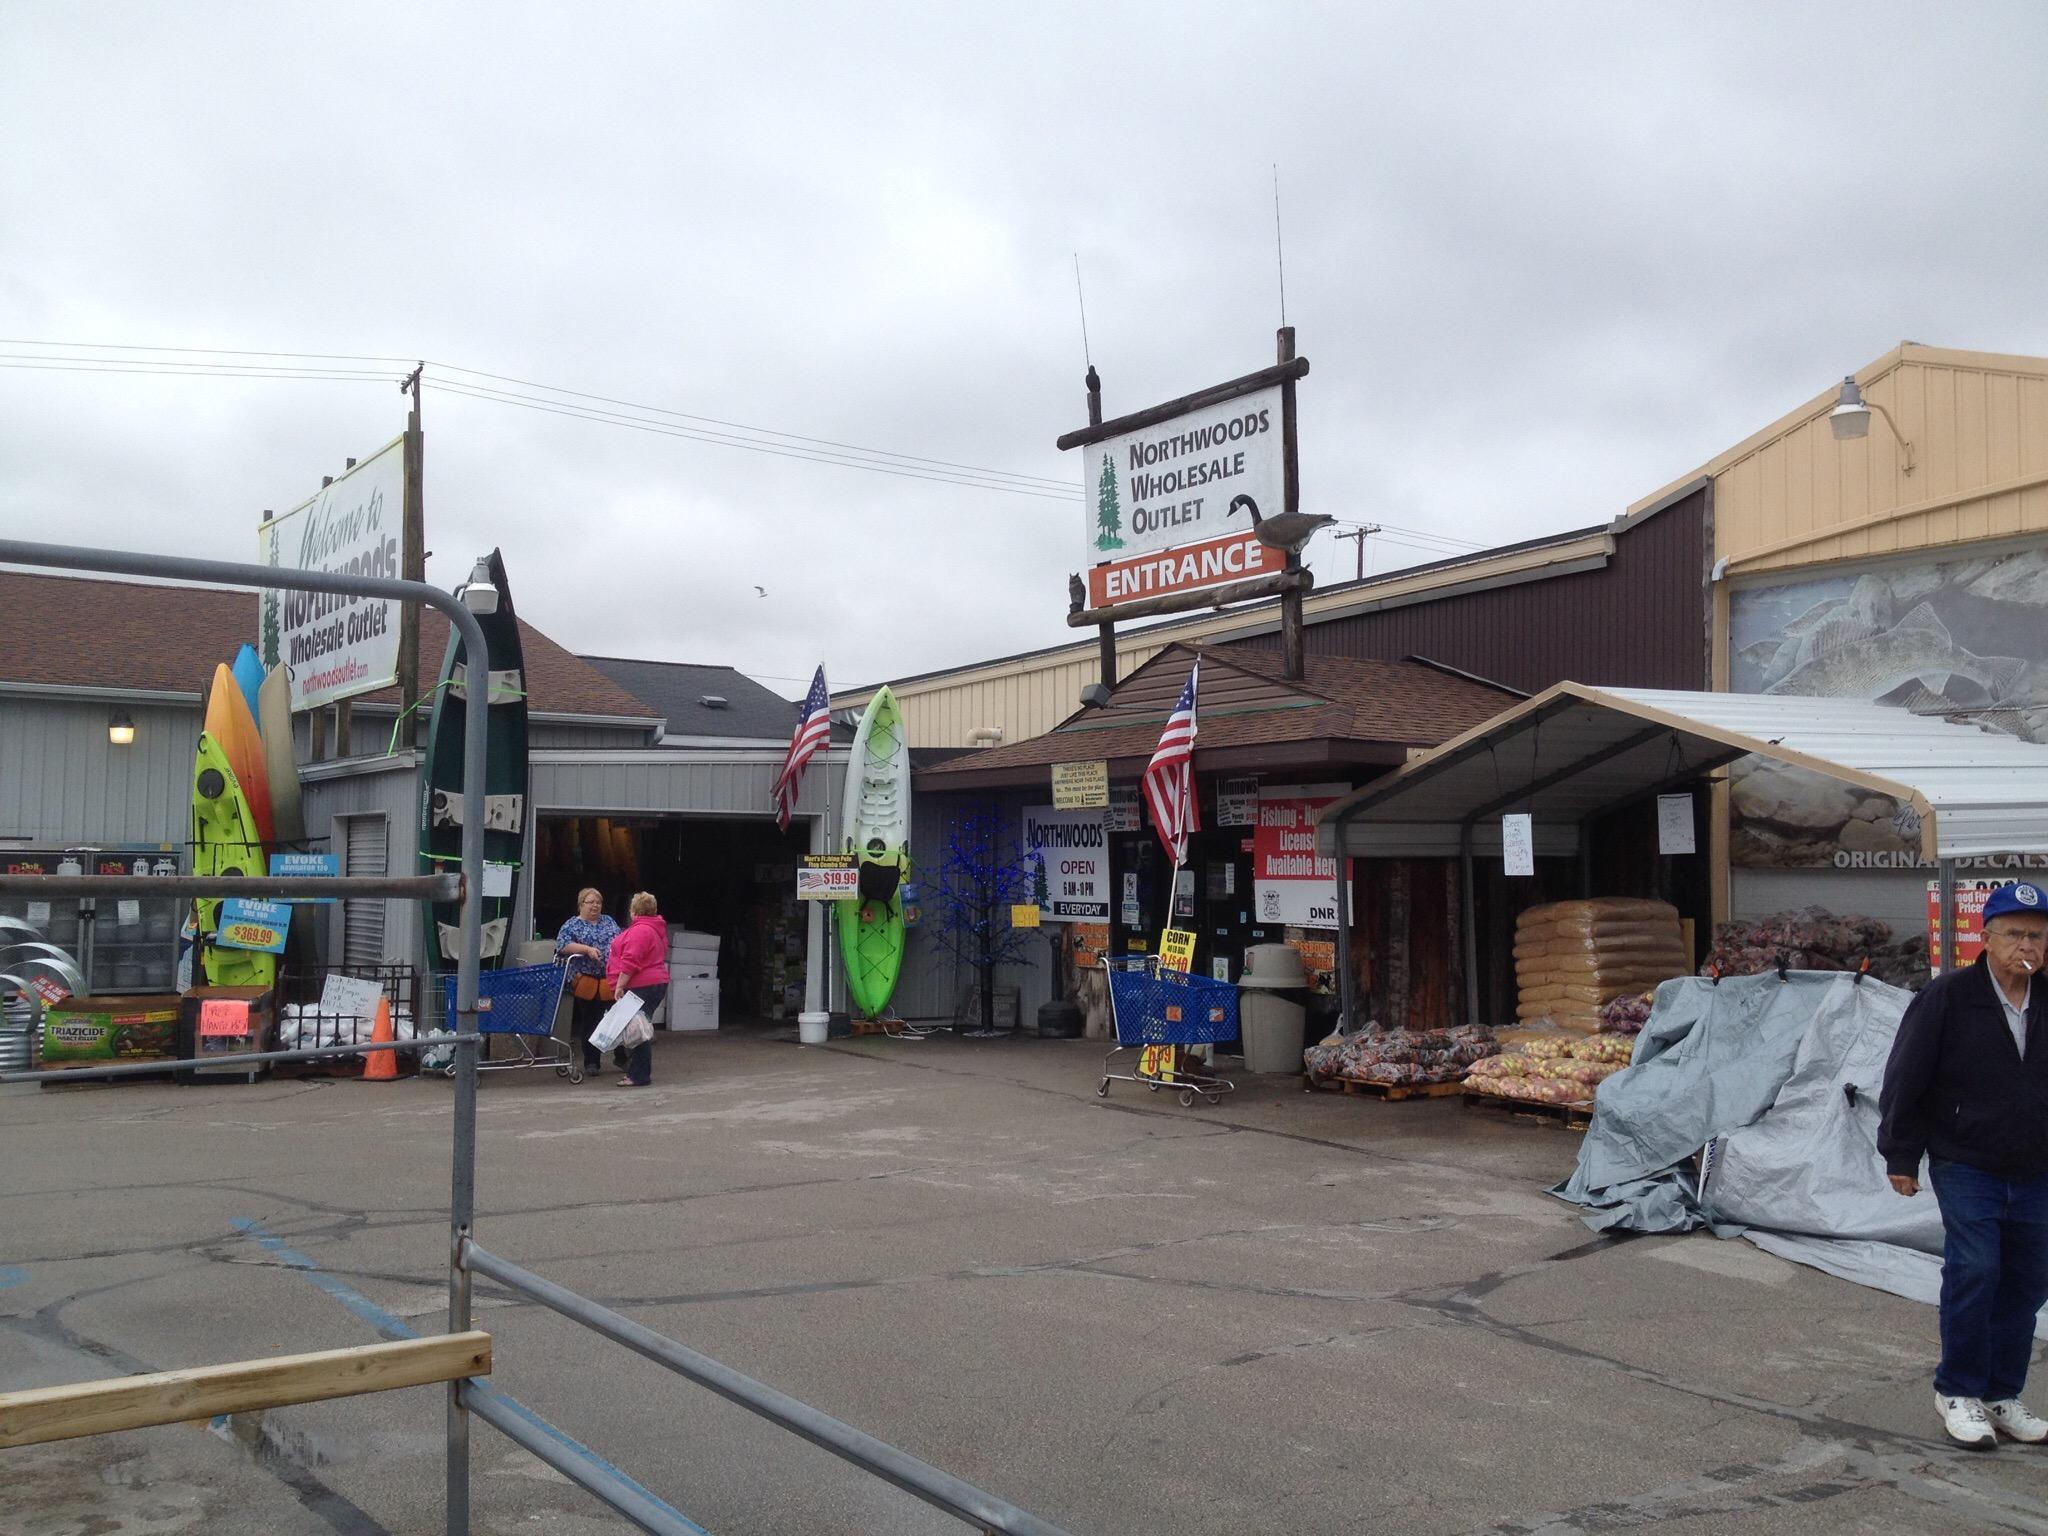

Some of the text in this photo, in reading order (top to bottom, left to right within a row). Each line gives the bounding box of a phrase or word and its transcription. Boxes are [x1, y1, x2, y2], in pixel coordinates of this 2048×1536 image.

[1129, 409, 1270, 470] NORTHWOODS
[1130, 451, 1245, 503] WHOLESALE
[1131, 498, 1204, 535] OUTLET
[300, 486, 383, 569] Welcome to
[1105, 540, 1263, 599] ENTRANCE
[290, 600, 388, 666] Wholesale Outlet
[302, 657, 369, 696] northwoodsoutlet.com
[1260, 806, 1297, 829] Fishing
[1027, 818, 1103, 848] NORTHWOODS
[285, 855, 324, 864] EVOKE
[1060, 860, 1095, 875] OPEN
[1266, 855, 1313, 876] Available
[1955, 854, 2048, 869] DECALS
[823, 871, 857, 886] $19.99
[1063, 881, 1067, 896] 6
[1068, 882, 1076, 896] AM
[1085, 882, 1094, 896] PM
[238, 900, 278, 912] EVOKE
[1060, 903, 1102, 916] EVERYDAY
[1310, 907, 1335, 920] DNR
[234, 926, 273, 944] $369.99
[1166, 931, 1190, 946] CORN
[1958, 932, 1981, 942] Bundles
[51, 1026, 105, 1036] TRIAZICIDE
